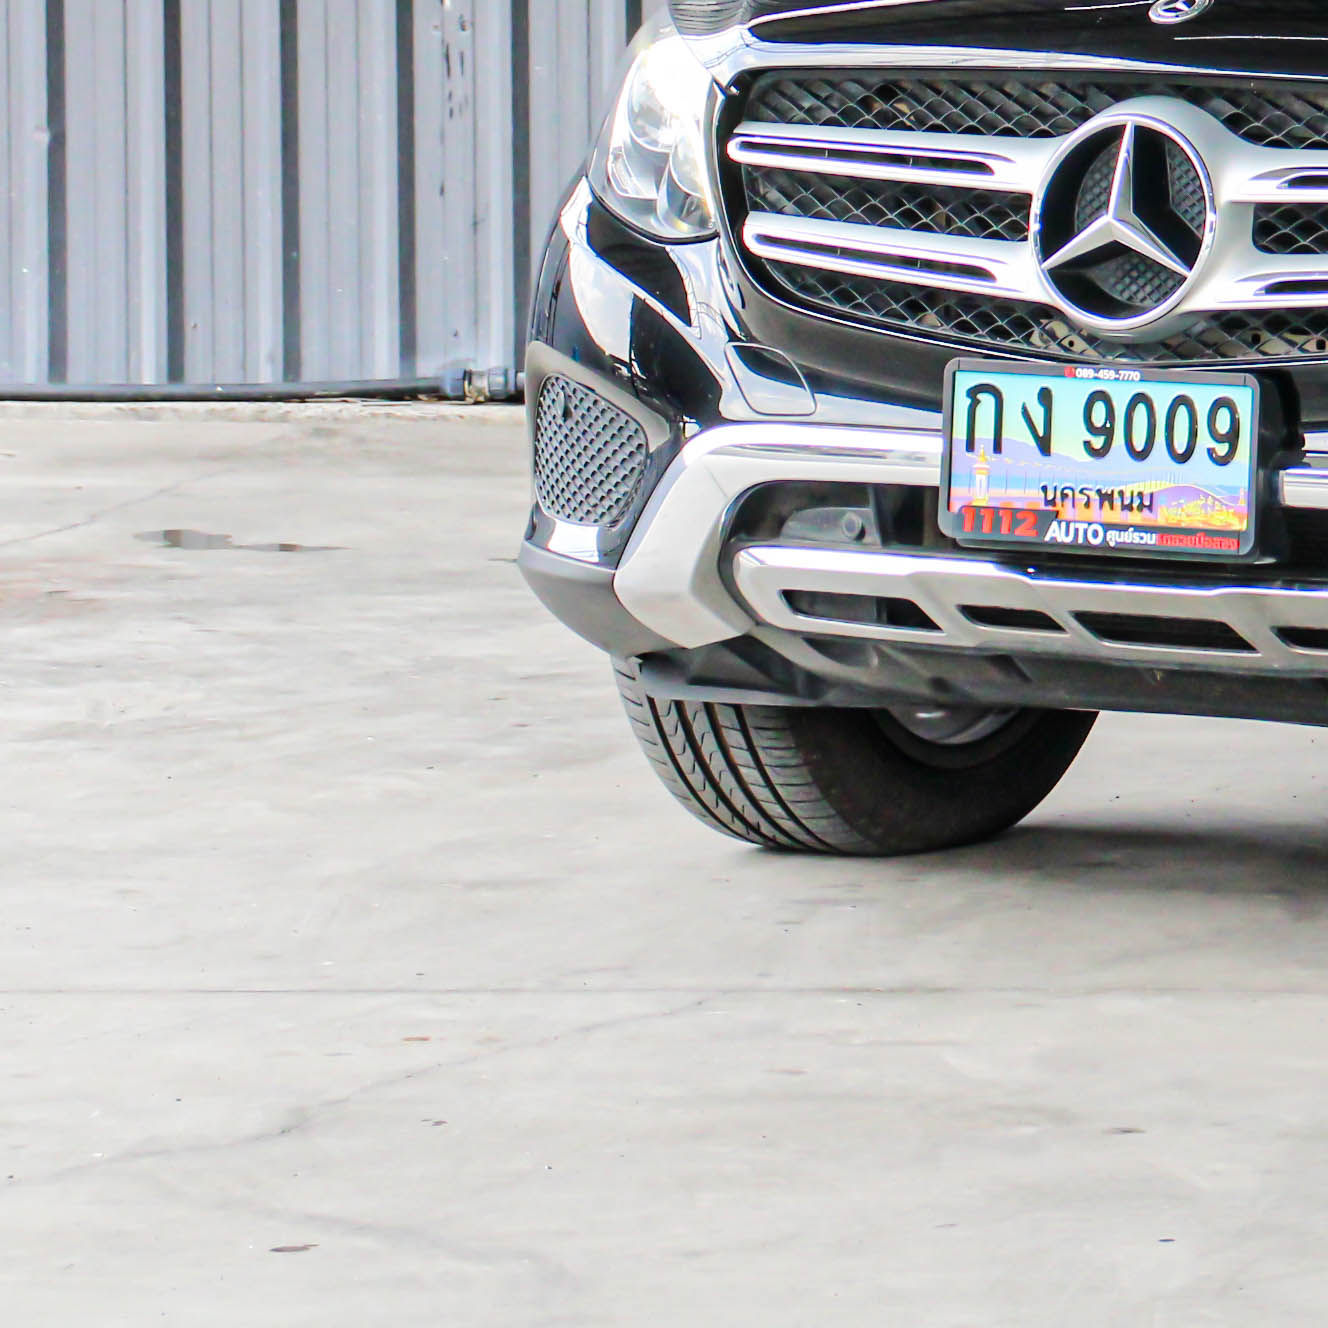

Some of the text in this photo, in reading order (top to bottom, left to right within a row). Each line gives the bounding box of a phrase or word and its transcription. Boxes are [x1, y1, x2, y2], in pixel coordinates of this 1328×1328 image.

[1075, 367, 1141, 381] 089-459-7770
[1082, 389, 1241, 467] 9009
[1040, 484, 1154, 513] นครพนม
[962, 507, 1105, 546] 1112 AUTO
